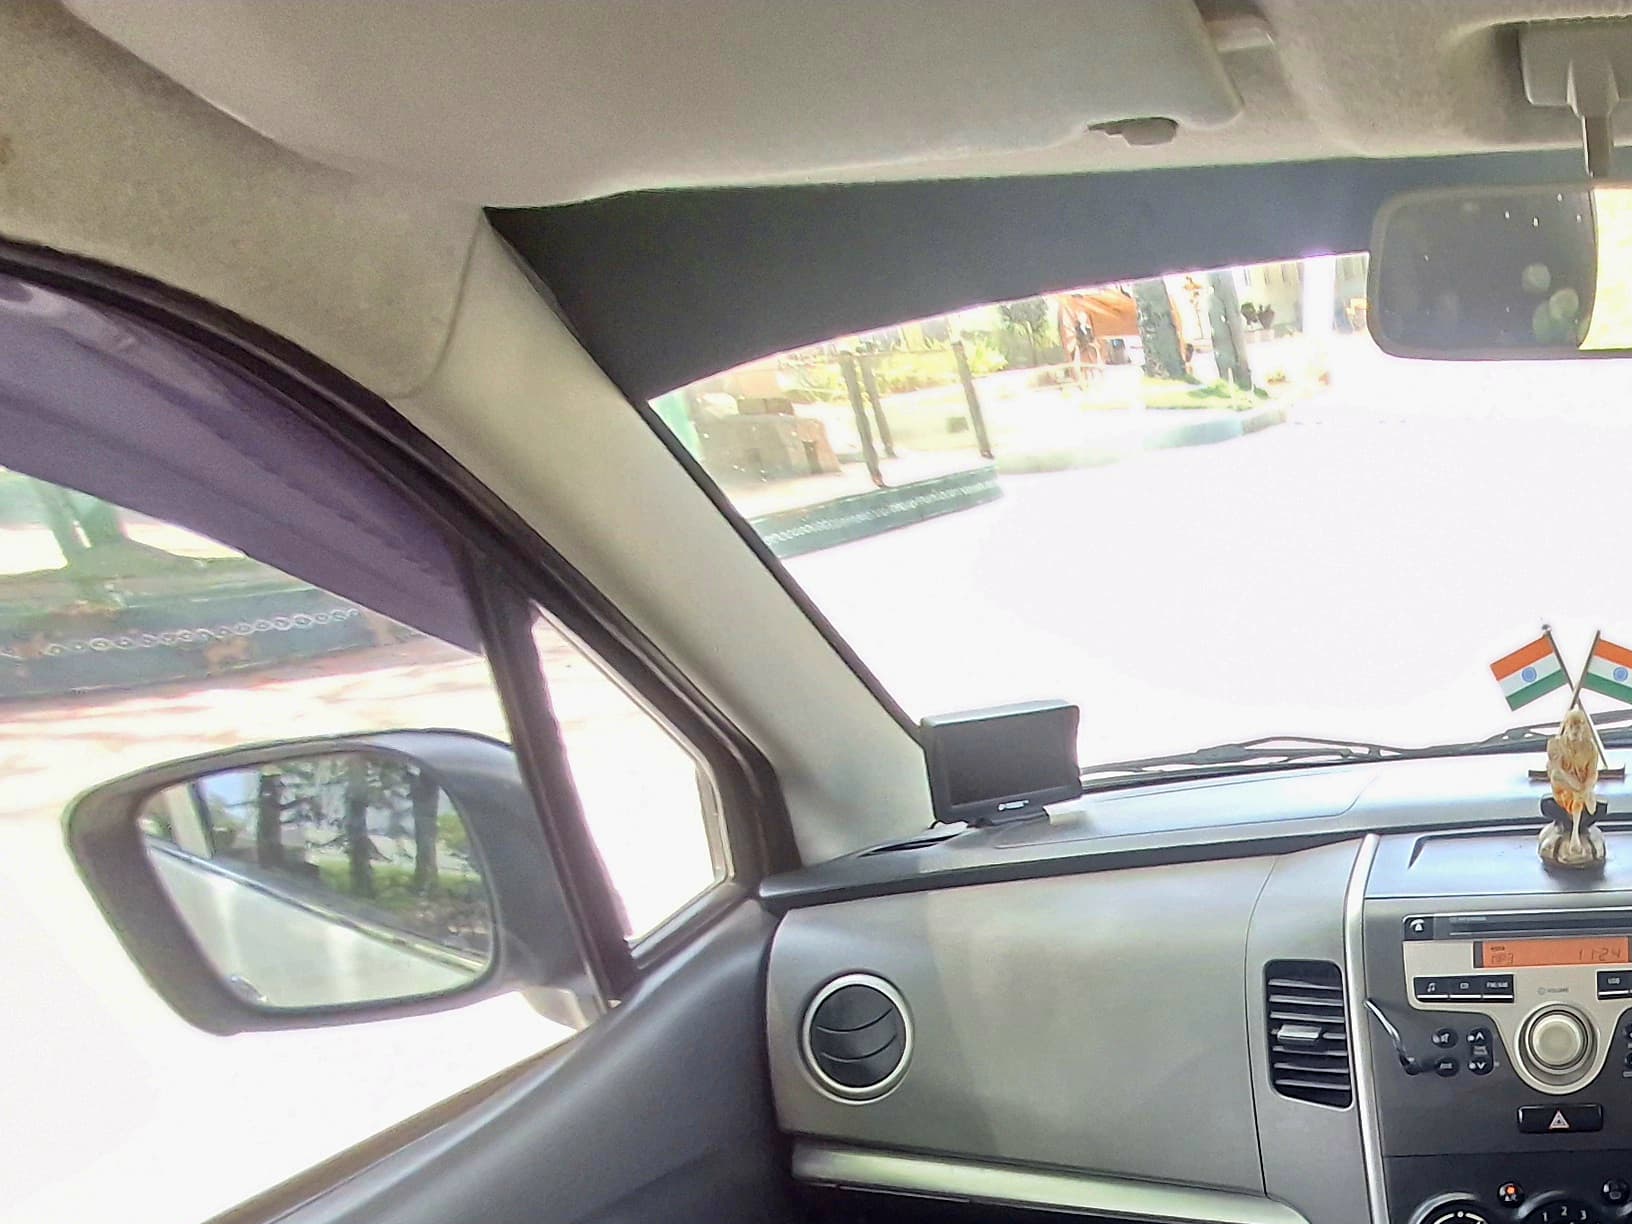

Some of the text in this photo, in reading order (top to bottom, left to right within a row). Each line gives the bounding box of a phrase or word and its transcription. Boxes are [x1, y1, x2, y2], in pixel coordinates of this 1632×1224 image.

[1542, 1211, 1548, 1221] 1
[1561, 1206, 1567, 1216] 2
[1580, 1209, 1587, 1220] 3
